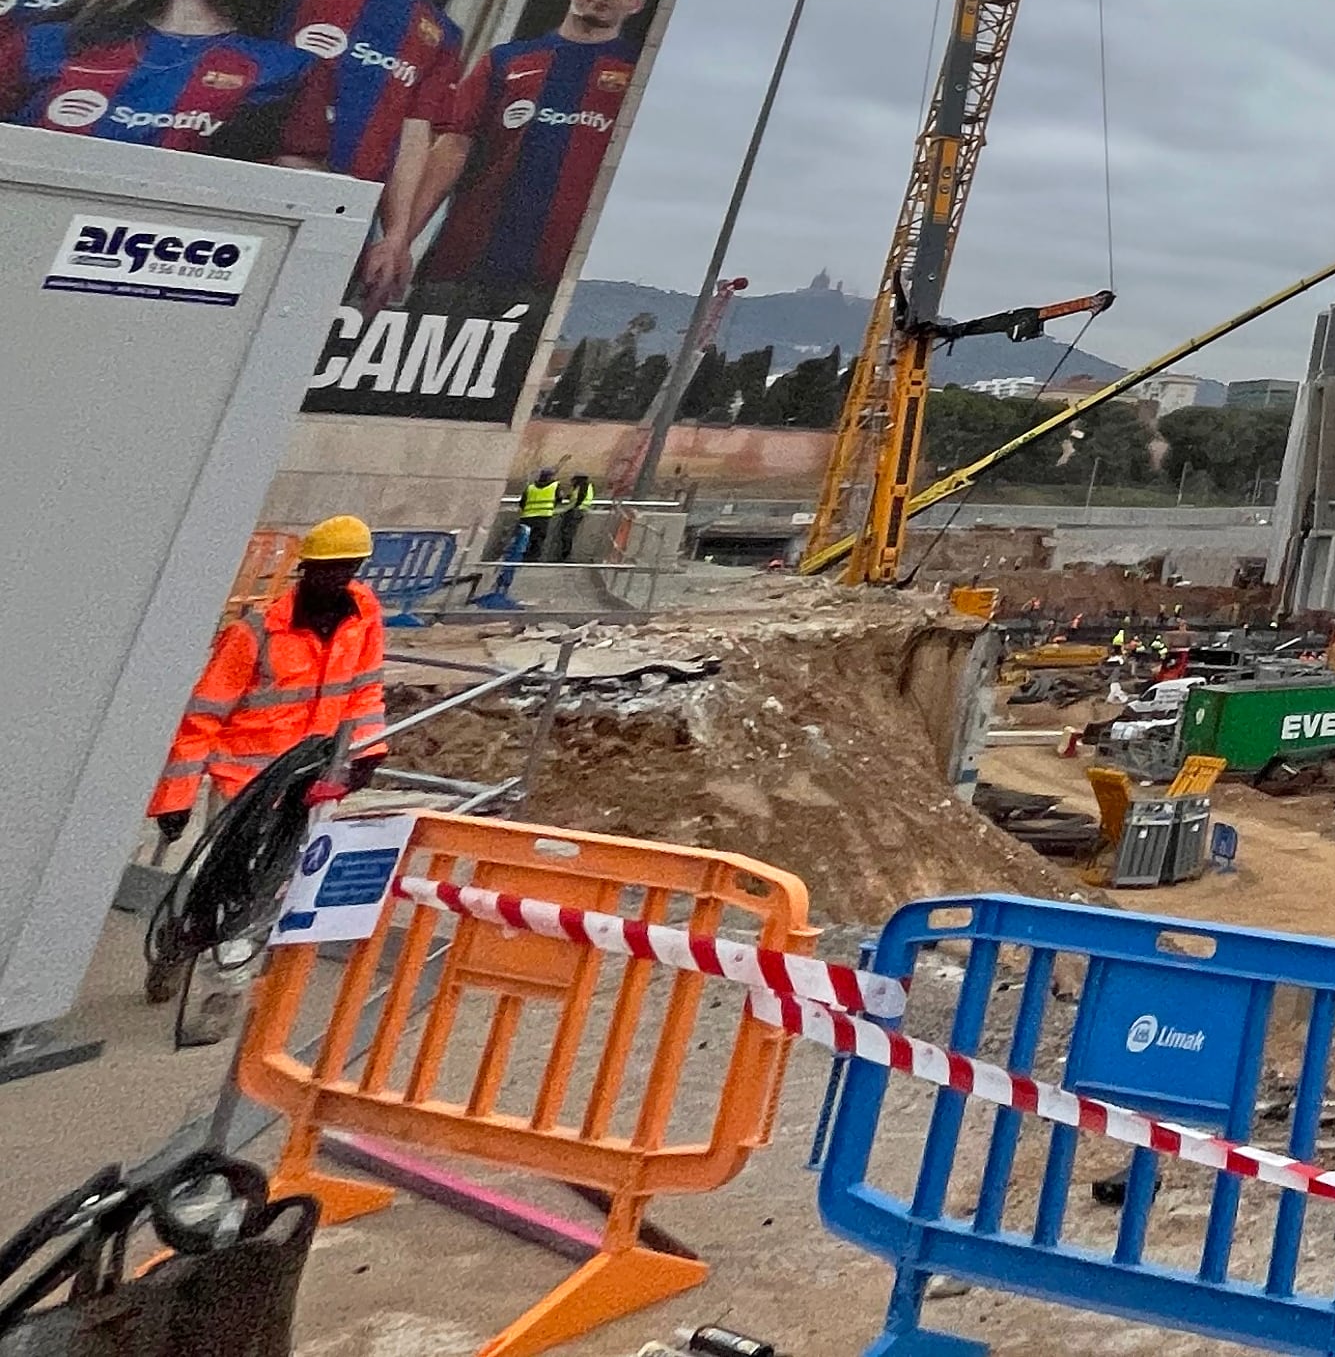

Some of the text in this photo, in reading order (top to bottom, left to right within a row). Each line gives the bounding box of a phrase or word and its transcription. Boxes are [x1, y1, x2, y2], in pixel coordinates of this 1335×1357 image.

[110, 105, 225, 137] Spotify
[537, 106, 613, 132] Spotify
[308, 303, 530, 399] CAMÍ
[1155, 1025, 1205, 1052] Limak
